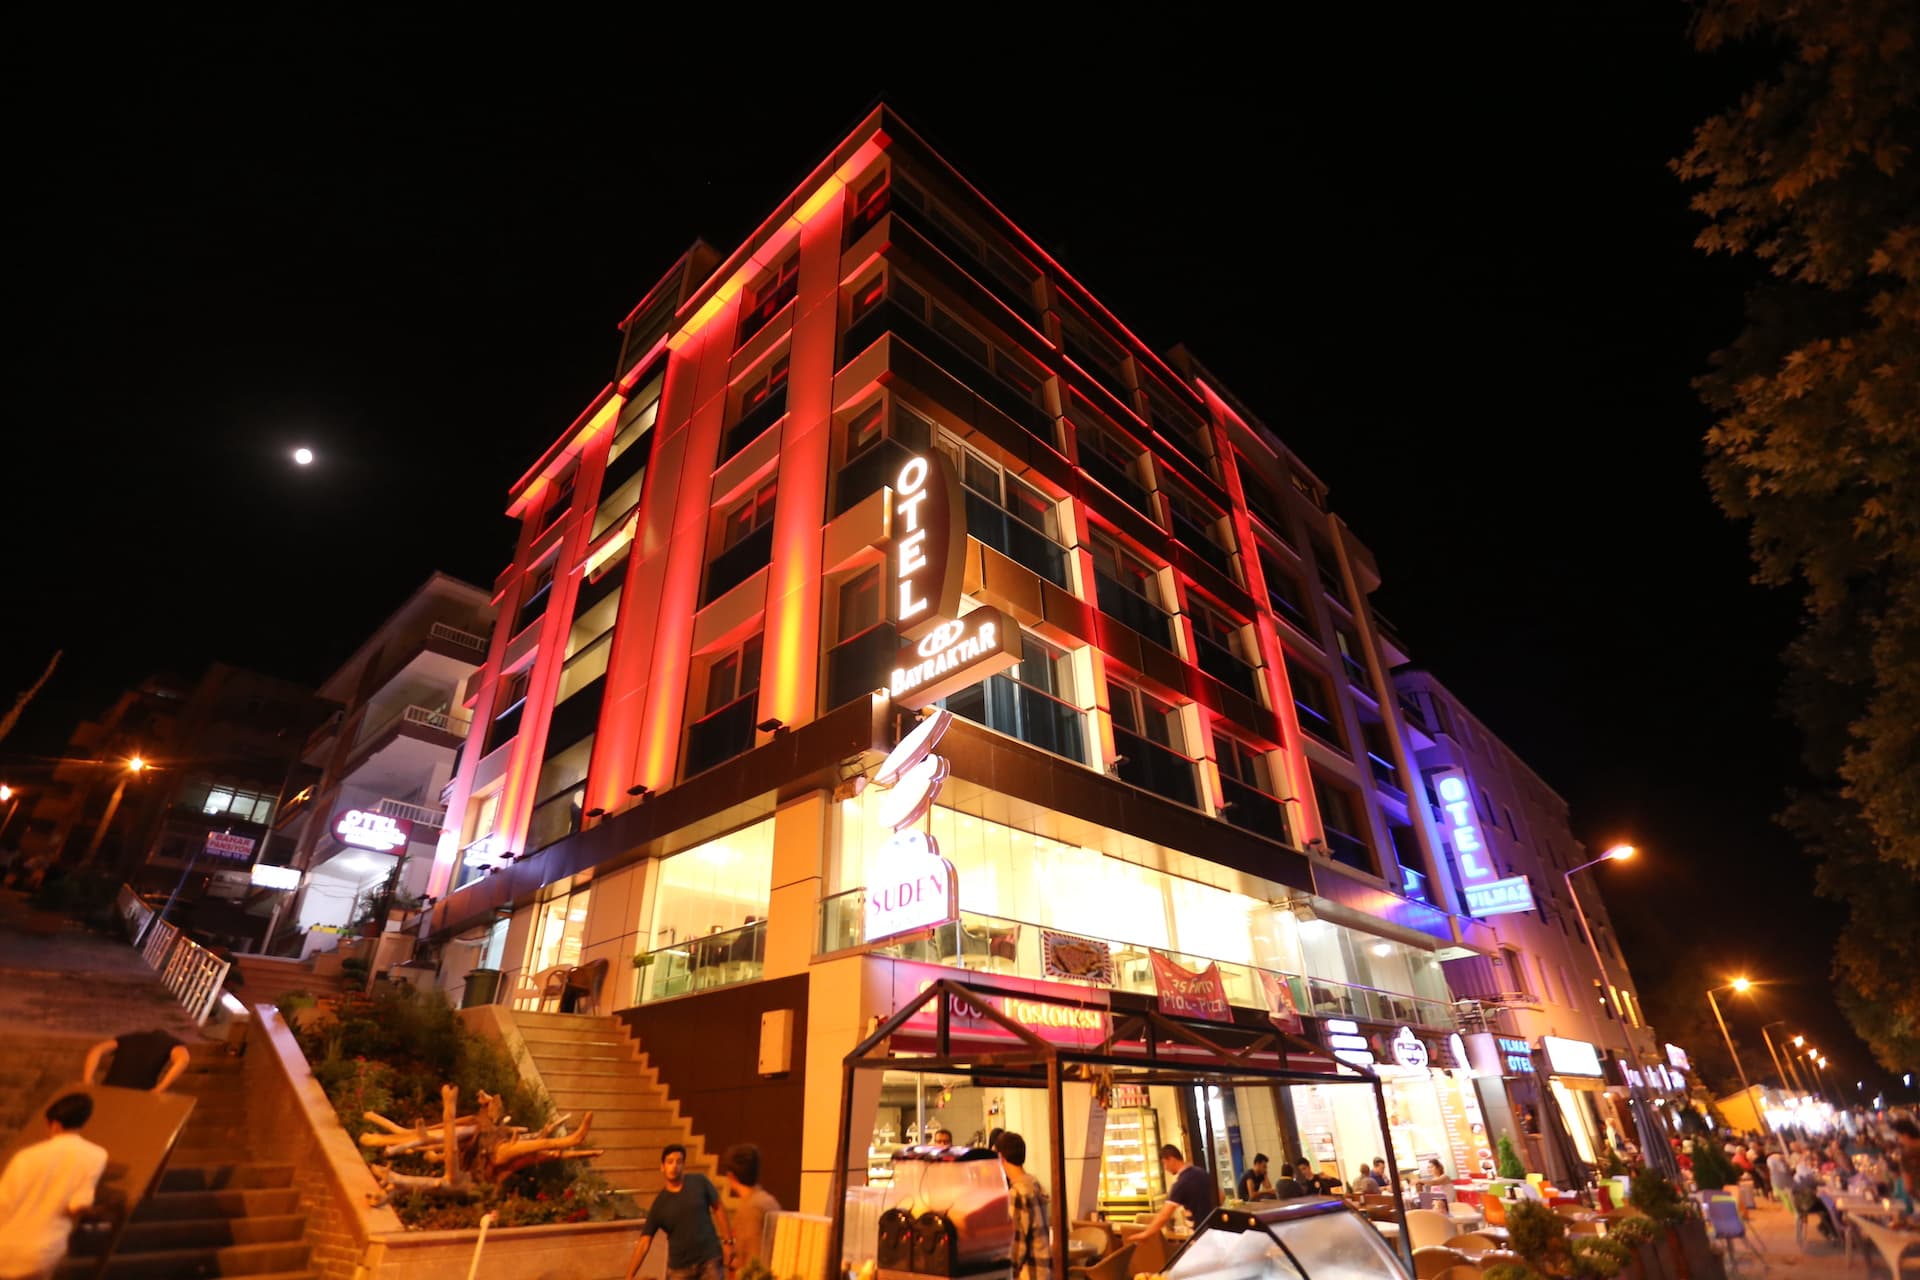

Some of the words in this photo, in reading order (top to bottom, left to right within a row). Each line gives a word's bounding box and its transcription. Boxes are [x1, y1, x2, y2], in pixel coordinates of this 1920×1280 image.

[897, 457, 928, 621] OTEL
[890, 621, 997, 698] BAYRAKTAR
[345, 809, 397, 832] OTEL
[1439, 777, 1489, 879] OTEL
[872, 874, 942, 916] SUDEN
[1465, 884, 1530, 908] YILMAZ
[1498, 1037, 1532, 1054] YILMAZ
[1506, 1055, 1536, 1073] OTEL
